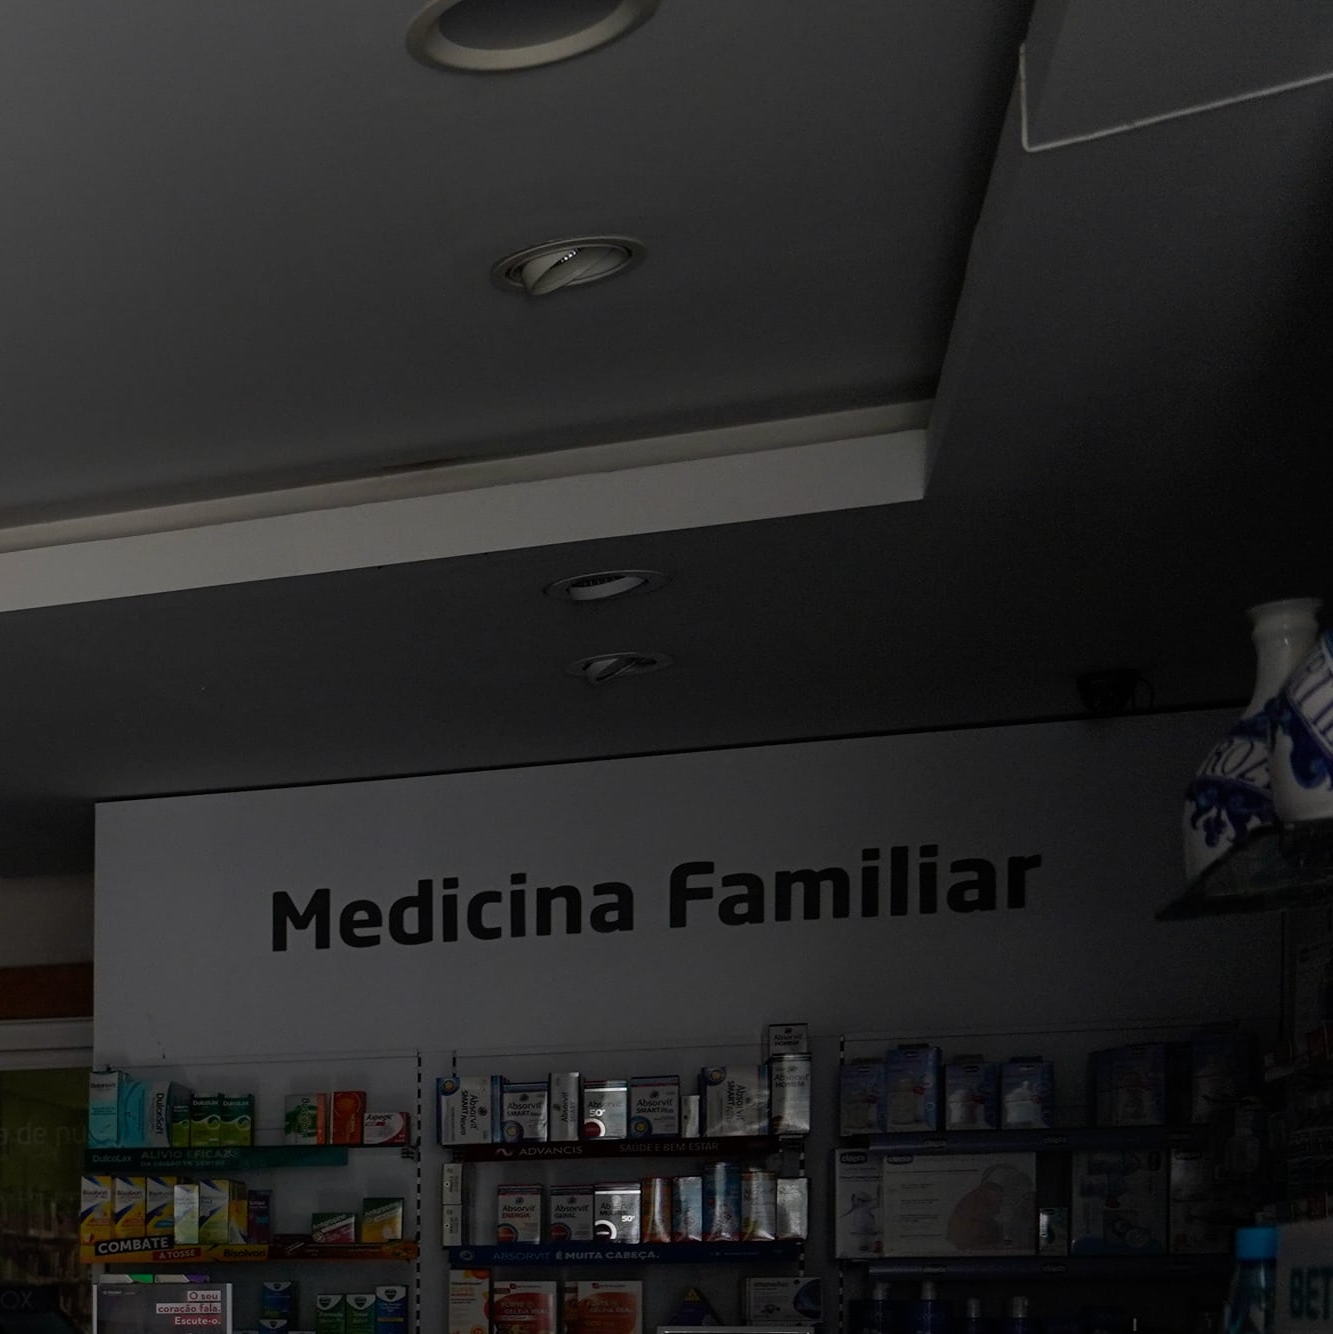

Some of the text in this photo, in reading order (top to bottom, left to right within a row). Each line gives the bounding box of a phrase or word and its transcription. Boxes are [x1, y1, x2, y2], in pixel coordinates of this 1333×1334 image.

[272, 844, 1041, 952] Medicina Familiar
[517, 1144, 583, 1157] ADVANCIS
[97, 1238, 169, 1255] COMBATE
[158, 1304, 197, 1314] coração
[174, 1316, 221, 1326] Escute-o.
